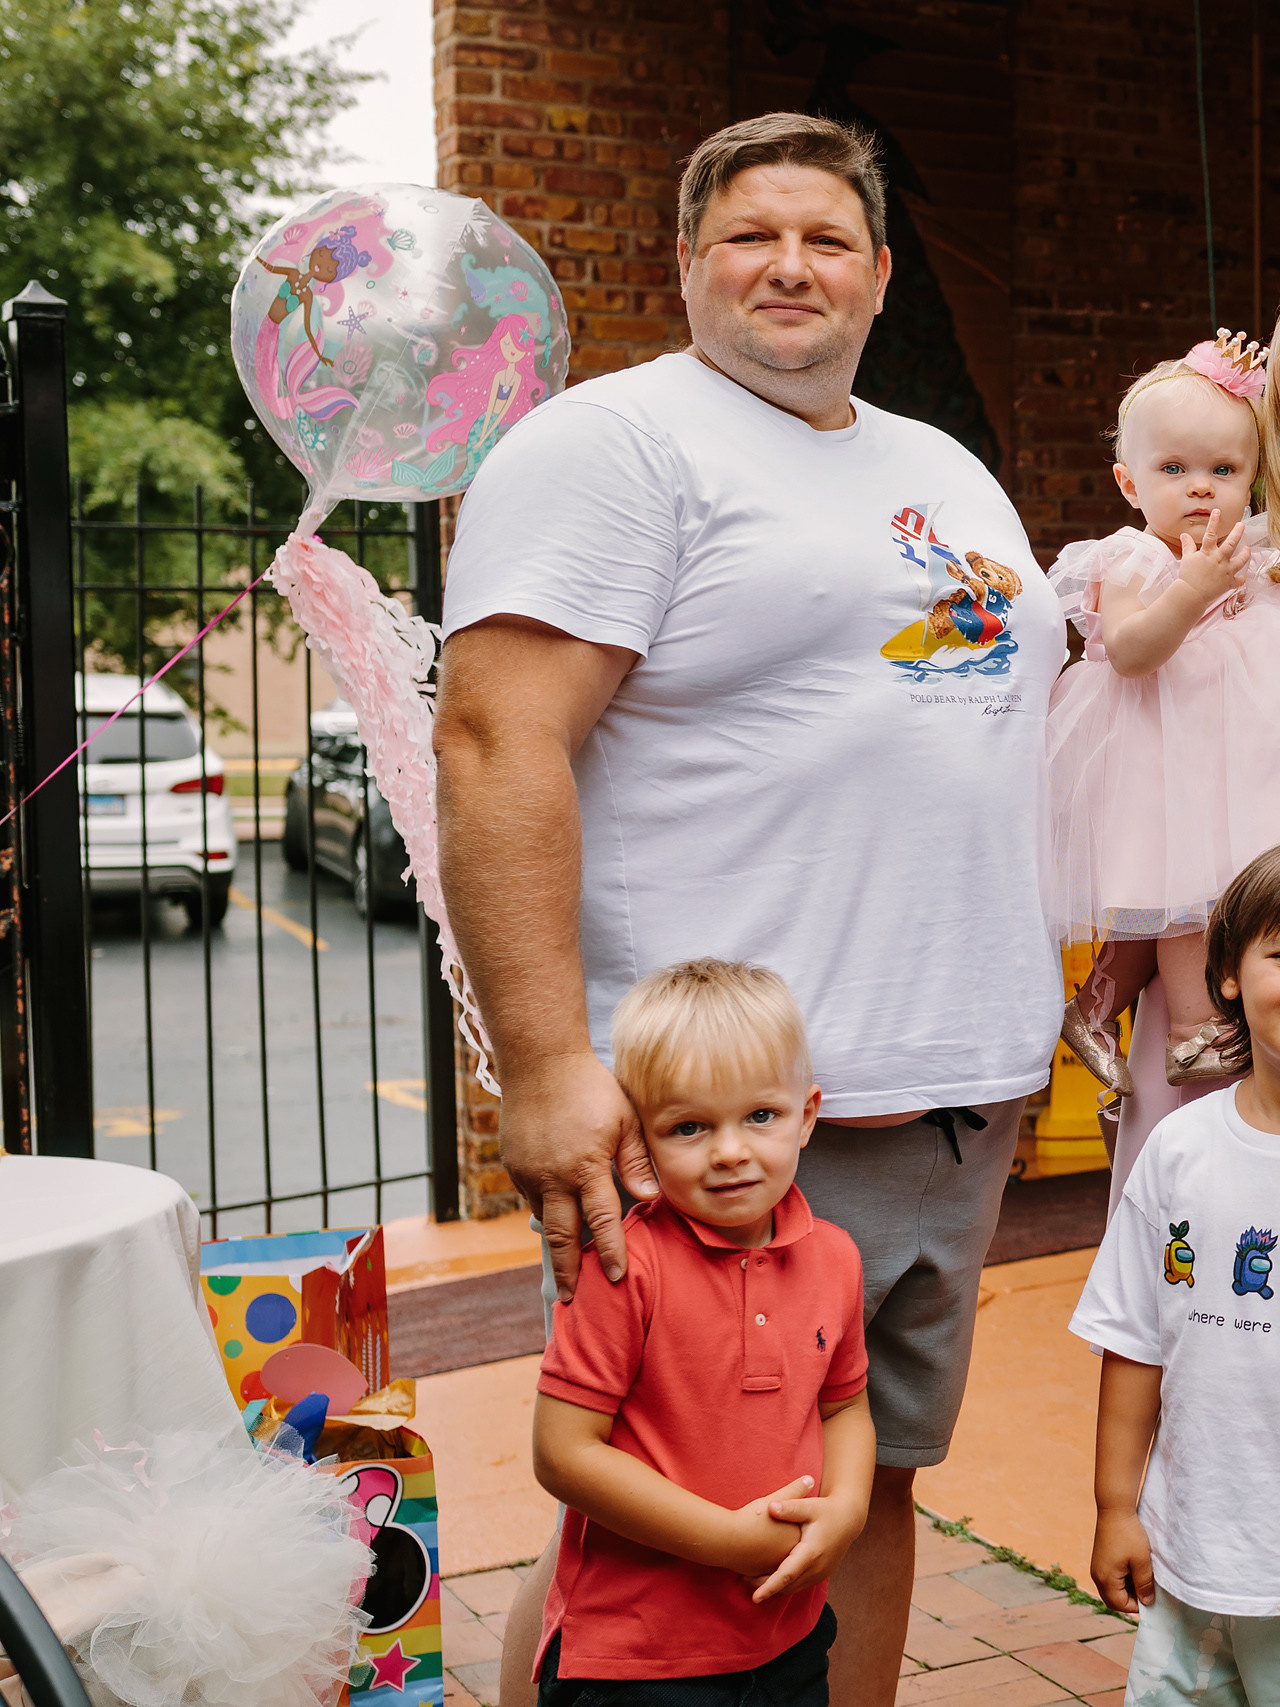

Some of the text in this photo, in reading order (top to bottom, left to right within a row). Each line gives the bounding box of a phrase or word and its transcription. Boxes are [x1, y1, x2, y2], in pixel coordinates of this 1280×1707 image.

[910, 694, 933, 704] POLO
[934, 694, 957, 704] BEAR
[958, 696, 967, 706] by
[968, 694, 995, 704] RALPH
[1234, 1318, 1272, 1333] were
